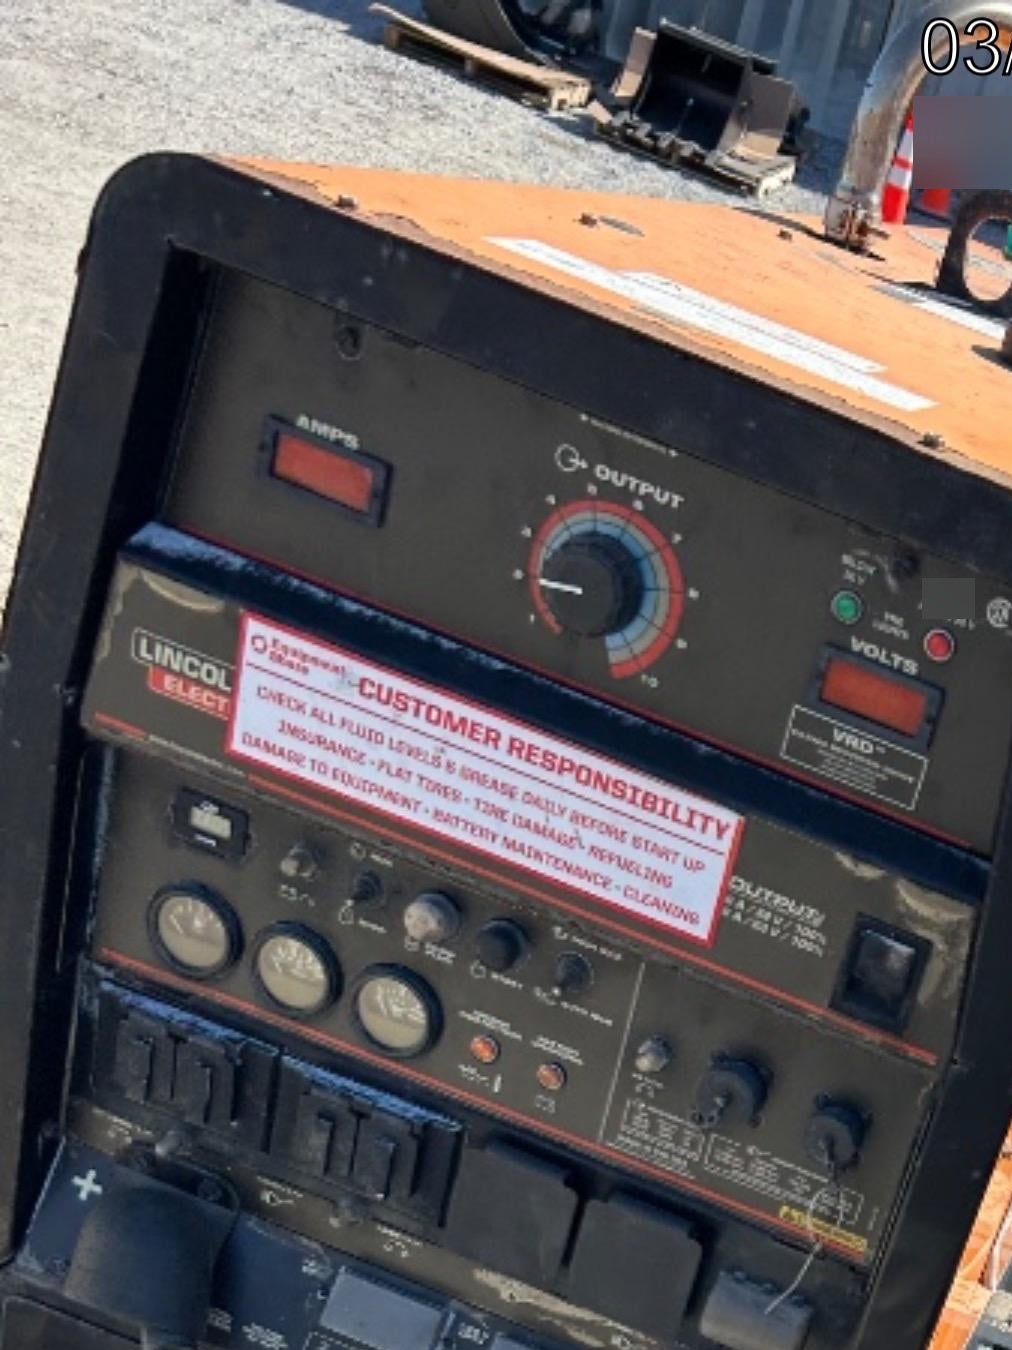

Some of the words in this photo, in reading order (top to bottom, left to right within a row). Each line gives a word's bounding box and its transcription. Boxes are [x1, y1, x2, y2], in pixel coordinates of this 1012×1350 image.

[295, 412, 359, 451] AMPS
[595, 463, 685, 508] OUTPUT
[139, 635, 232, 694] LINCOL
[850, 634, 919, 676] VOLTS
[163, 673, 231, 713] ELECT
[257, 685, 307, 716] CHECK
[309, 706, 337, 728] ALL
[340, 715, 385, 746] FLUID
[388, 736, 442, 770] LEVELS
[459, 766, 519, 799] GREASE
[521, 790, 568, 820] DAILY
[569, 809, 629, 844] BEFORE
[631, 835, 681, 865] START
[682, 857, 706, 874] UP
[358, 676, 502, 751] CUSTOMER
[508, 735, 731, 841] RESPONSIBILITY
[277, 719, 367, 766] INSURANCE
[377, 754, 415, 783] FLAT
[416, 773, 463, 804] TIRES
[473, 796, 510, 824] TIRE
[588, 843, 674, 889] REFUELING
[309, 757, 329, 775] TO
[331, 766, 423, 814] EQUIPMENT
[431, 803, 500, 845] BATTERY
[502, 832, 614, 891] MAINTENANCE
[623, 883, 701, 926] CLEANING
